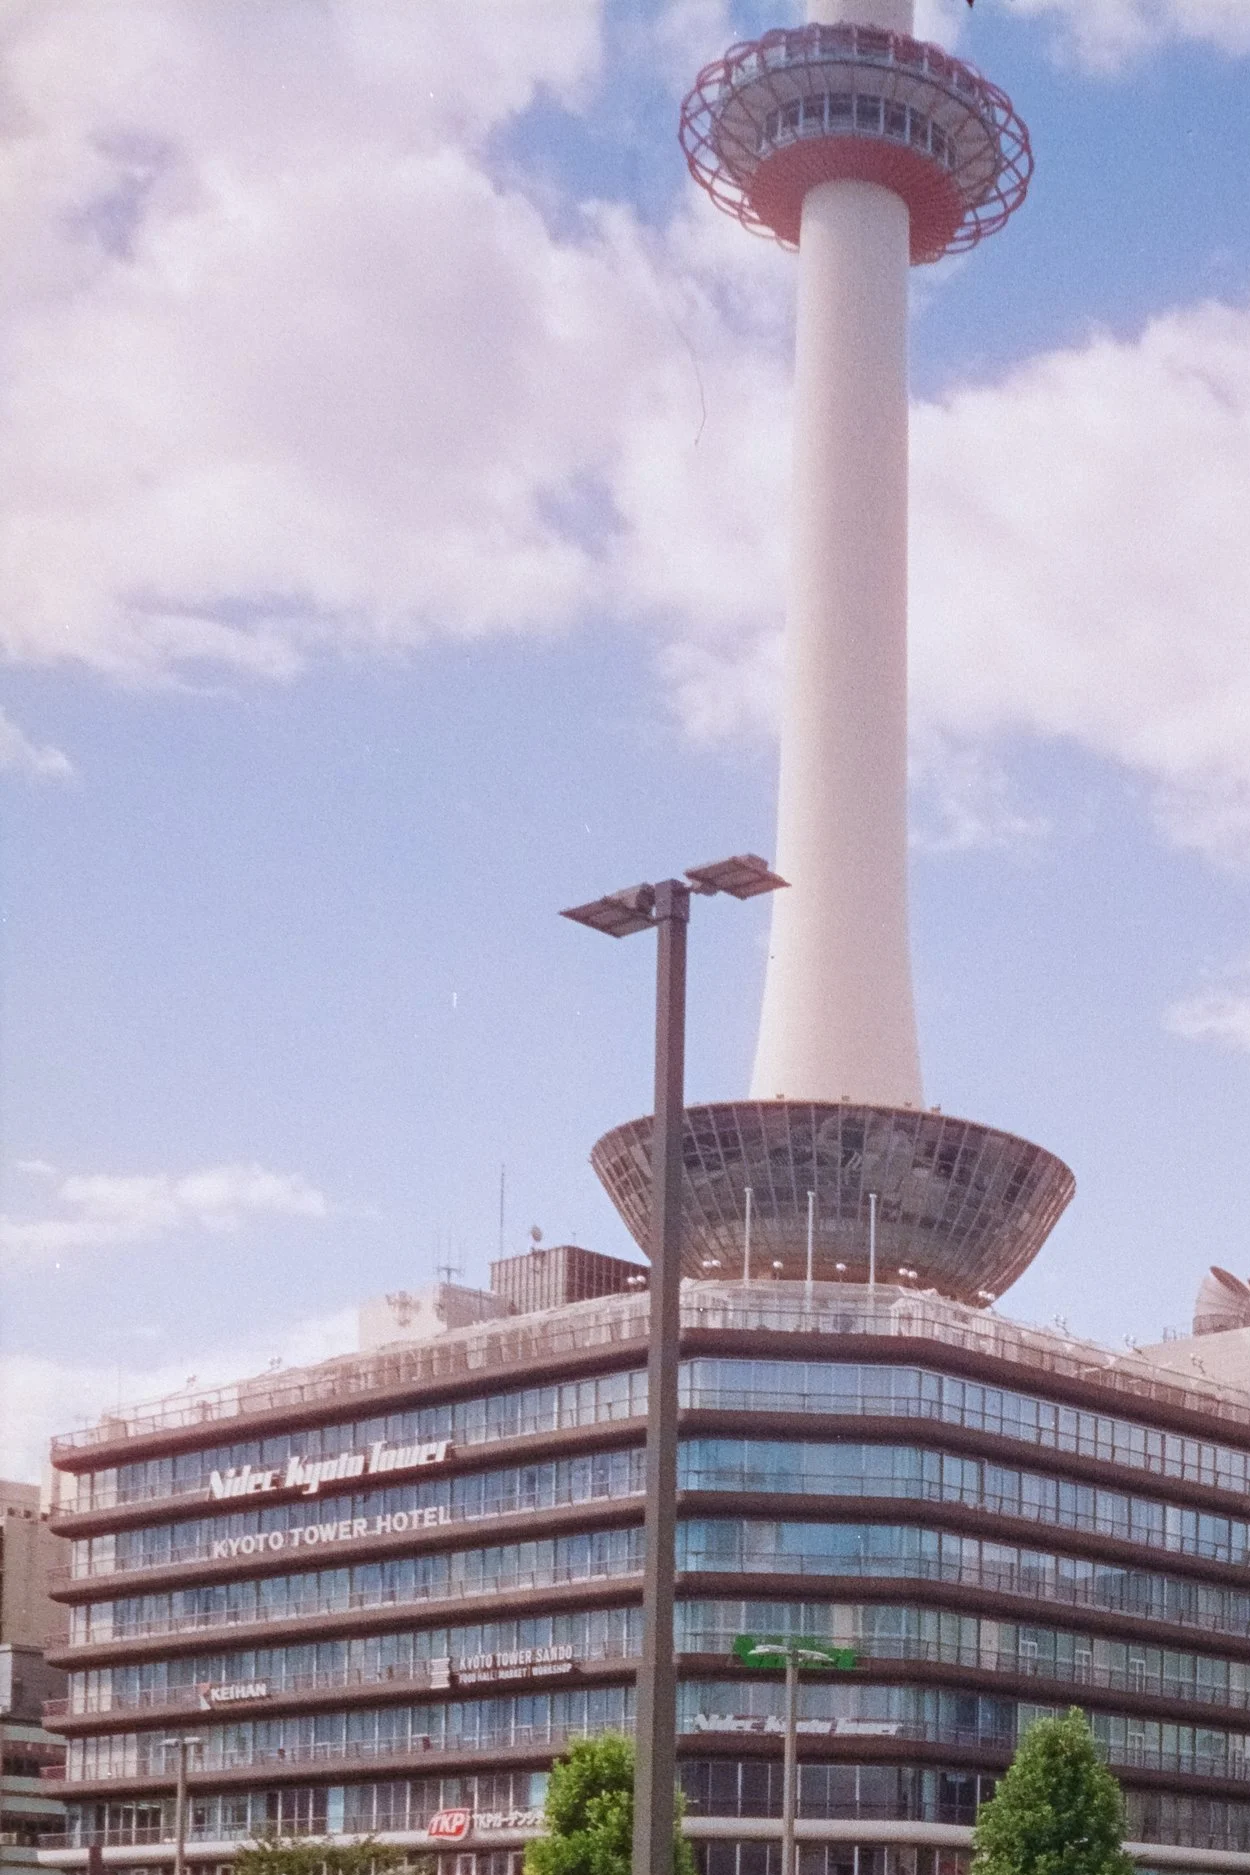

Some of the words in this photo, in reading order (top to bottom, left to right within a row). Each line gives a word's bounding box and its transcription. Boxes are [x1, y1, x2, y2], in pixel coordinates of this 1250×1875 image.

[210, 1464, 281, 1499] Nidec
[284, 1452, 364, 1495] Kyoto
[368, 1440, 453, 1474] Tower
[212, 1531, 284, 1558] KYOTO
[290, 1517, 368, 1548] TOWER
[375, 1506, 452, 1536] HOTEL
[459, 1653, 493, 1671] KYOTO
[495, 1649, 532, 1667] TOWER
[535, 1645, 573, 1663] SANDO
[211, 1683, 267, 1702] KEIHAN
[429, 1813, 466, 1835] TKP
